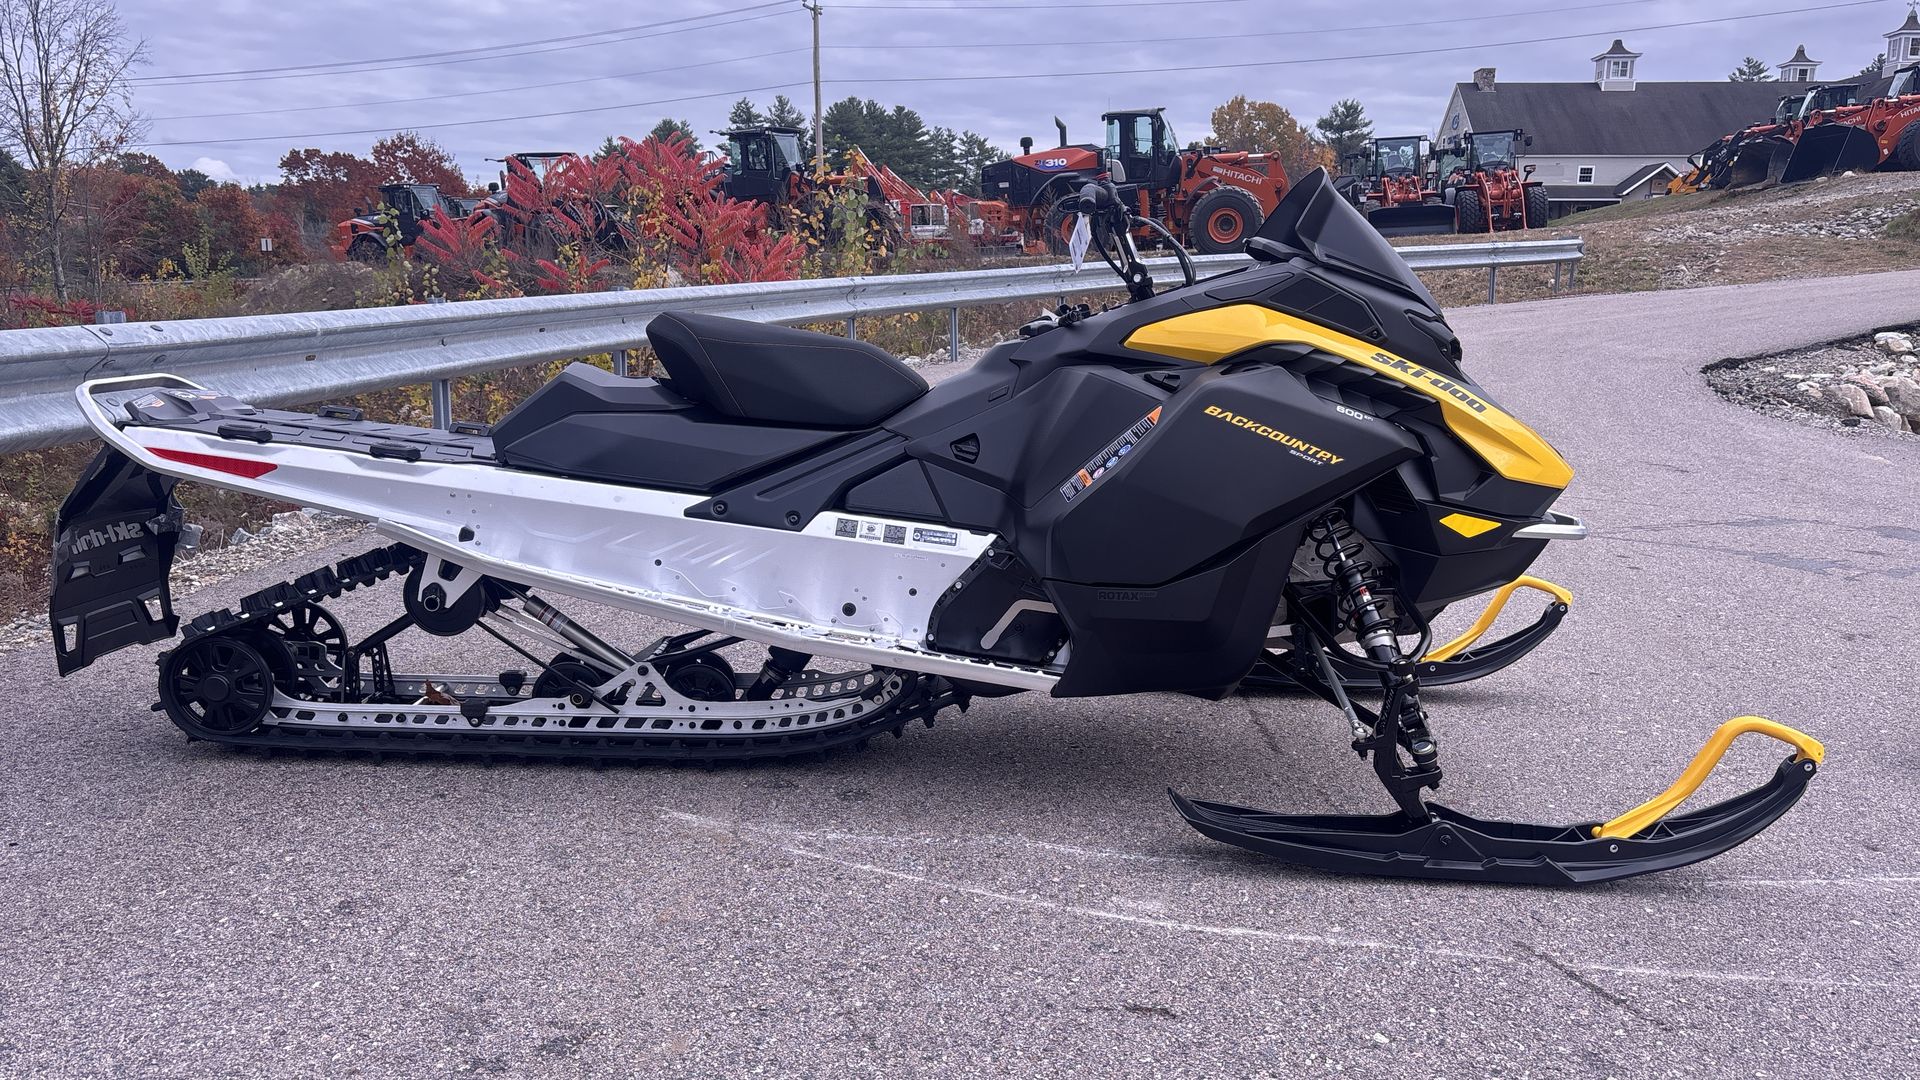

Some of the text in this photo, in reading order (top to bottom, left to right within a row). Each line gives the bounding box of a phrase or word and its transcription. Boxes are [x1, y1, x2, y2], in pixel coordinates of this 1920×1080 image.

[1841, 115, 1862, 125] ACHI
[1222, 168, 1263, 185] HITACHI
[1370, 352, 1487, 413] ski-doo
[1336, 405, 1364, 420] 600
[1204, 405, 1345, 465] BACKCOUNTRY
[1288, 449, 1325, 466] SPORT
[1098, 591, 1139, 601] ROTAX
